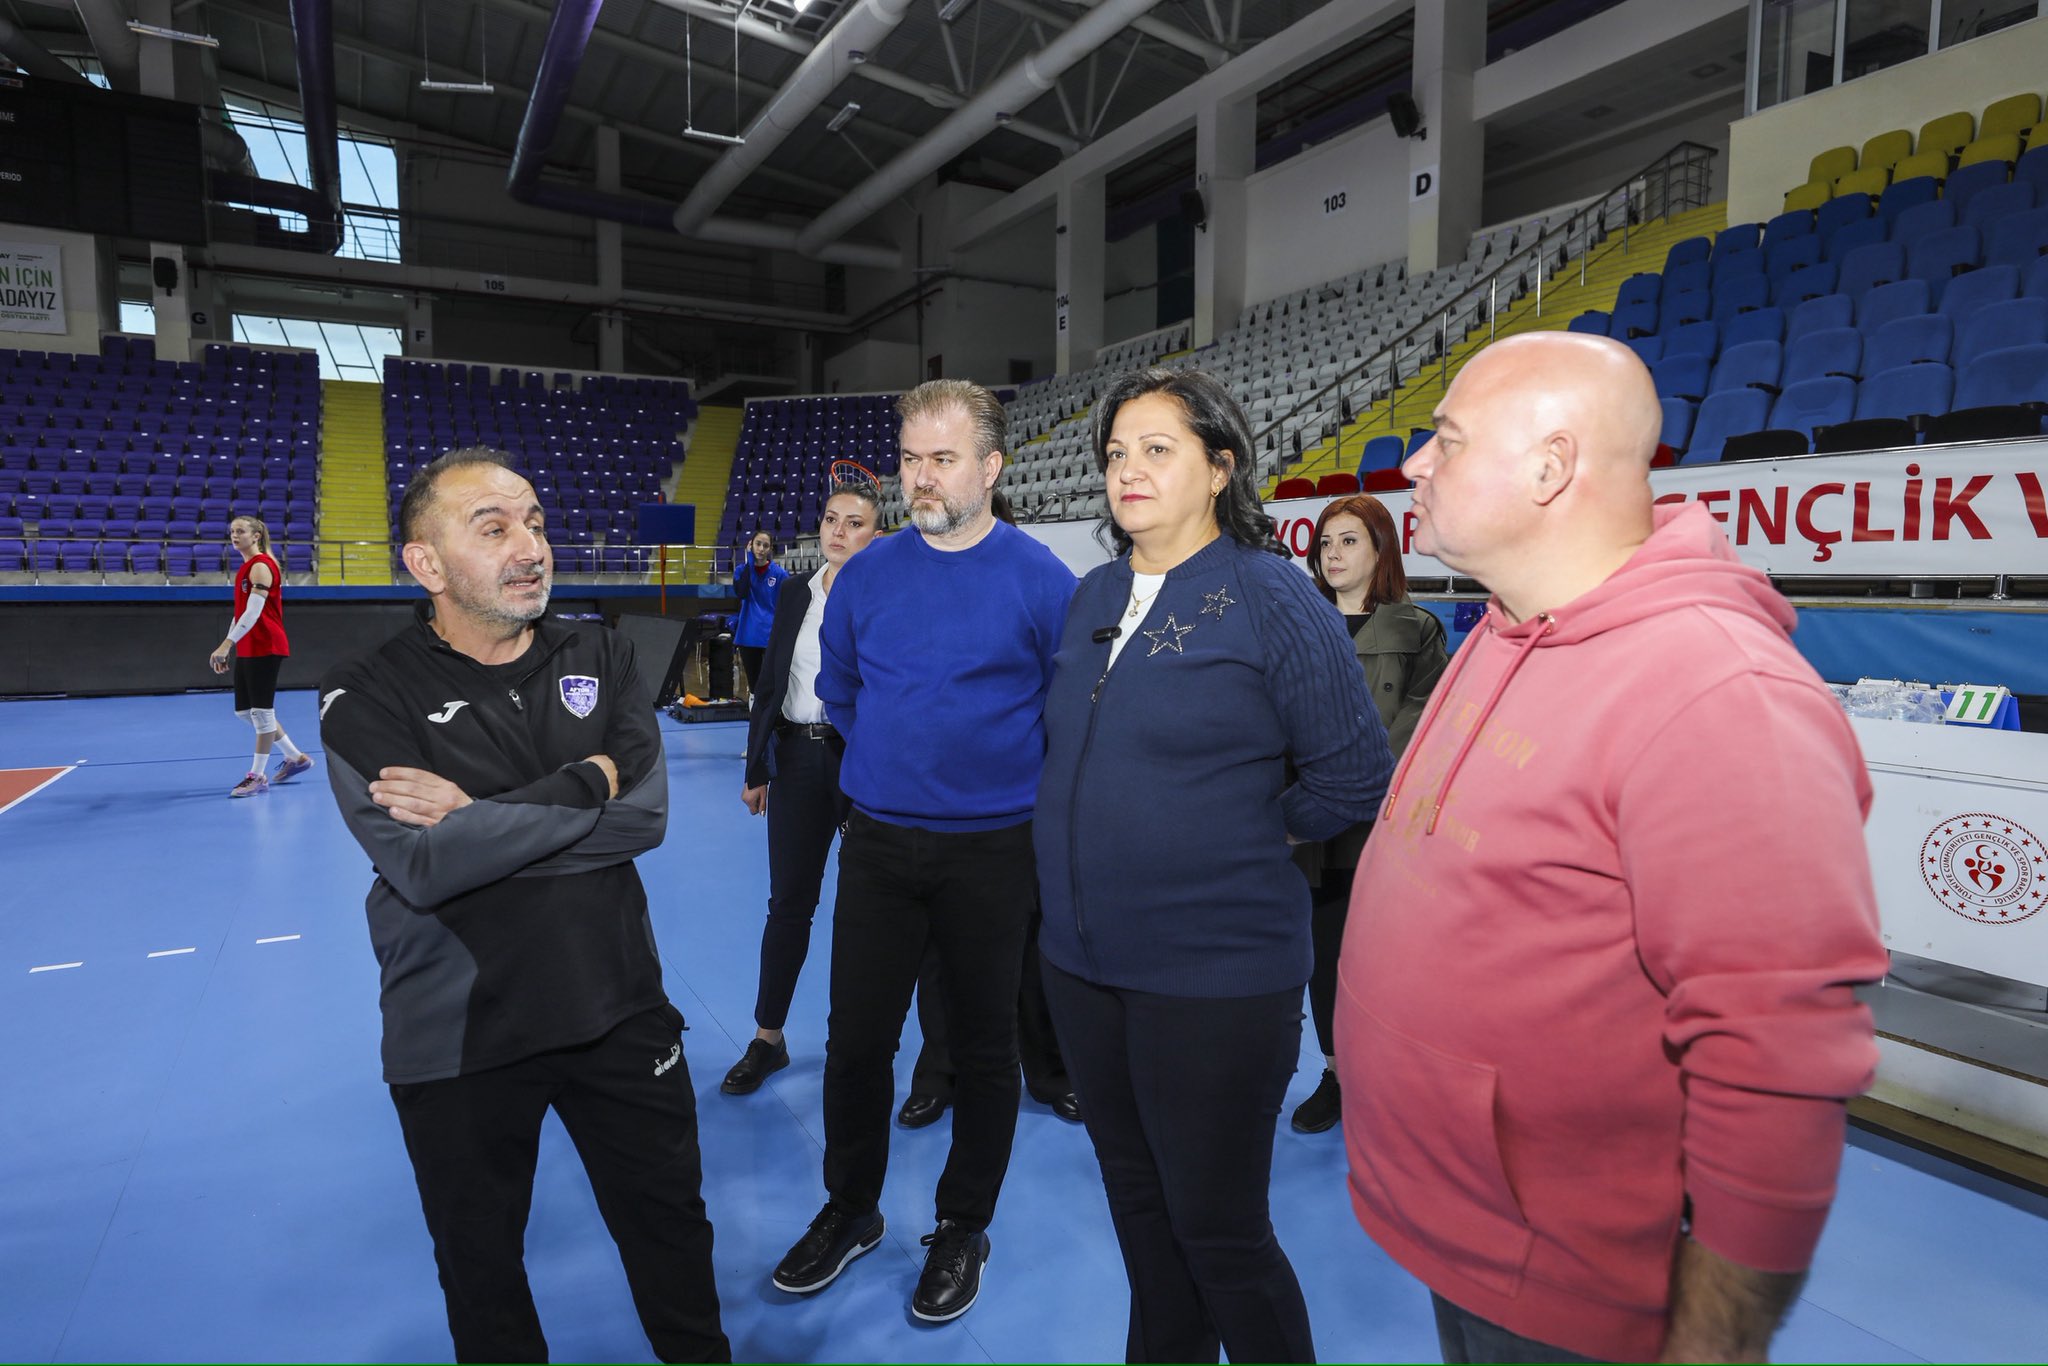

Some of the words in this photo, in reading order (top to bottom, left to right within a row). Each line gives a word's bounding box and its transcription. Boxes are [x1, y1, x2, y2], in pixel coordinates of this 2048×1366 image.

[1416, 172, 1432, 197] D
[1324, 192, 1346, 214] 103
[16, 264, 53, 288] İÇİN
[484, 279, 505, 291] 105
[191, 311, 207, 325] G
[1059, 315, 1066, 331] E
[415, 330, 425, 342] F
[1955, 690, 1996, 720] 11
[1974, 833, 2011, 849] GENÇLİK
[2010, 845, 2021, 857] VE
[2017, 856, 2028, 876] SPOR
